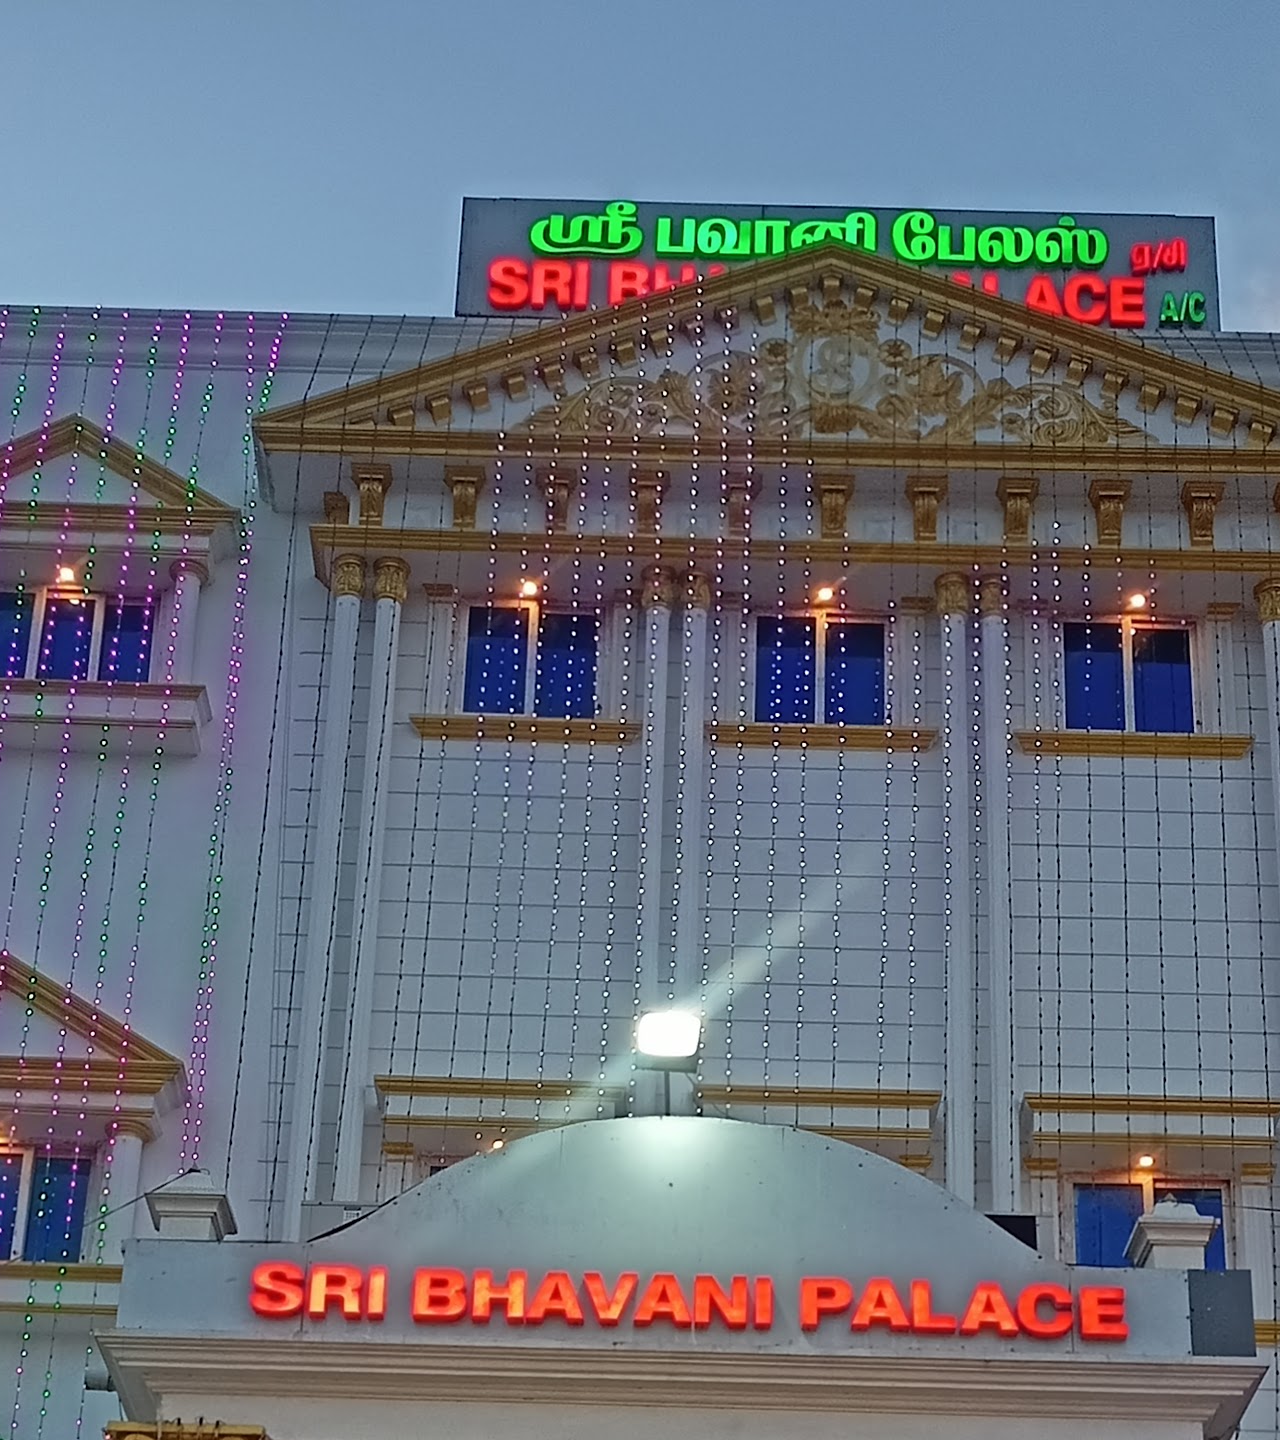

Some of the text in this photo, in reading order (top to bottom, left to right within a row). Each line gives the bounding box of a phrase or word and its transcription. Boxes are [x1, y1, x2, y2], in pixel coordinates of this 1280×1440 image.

[892, 212, 1109, 266] பேலஸ்
[488, 258, 590, 310] SRI
[952, 271, 1146, 328] ACE
[1160, 292, 1207, 328] A/C
[249, 1261, 1129, 1342] SRI BHAVANI PALACE
